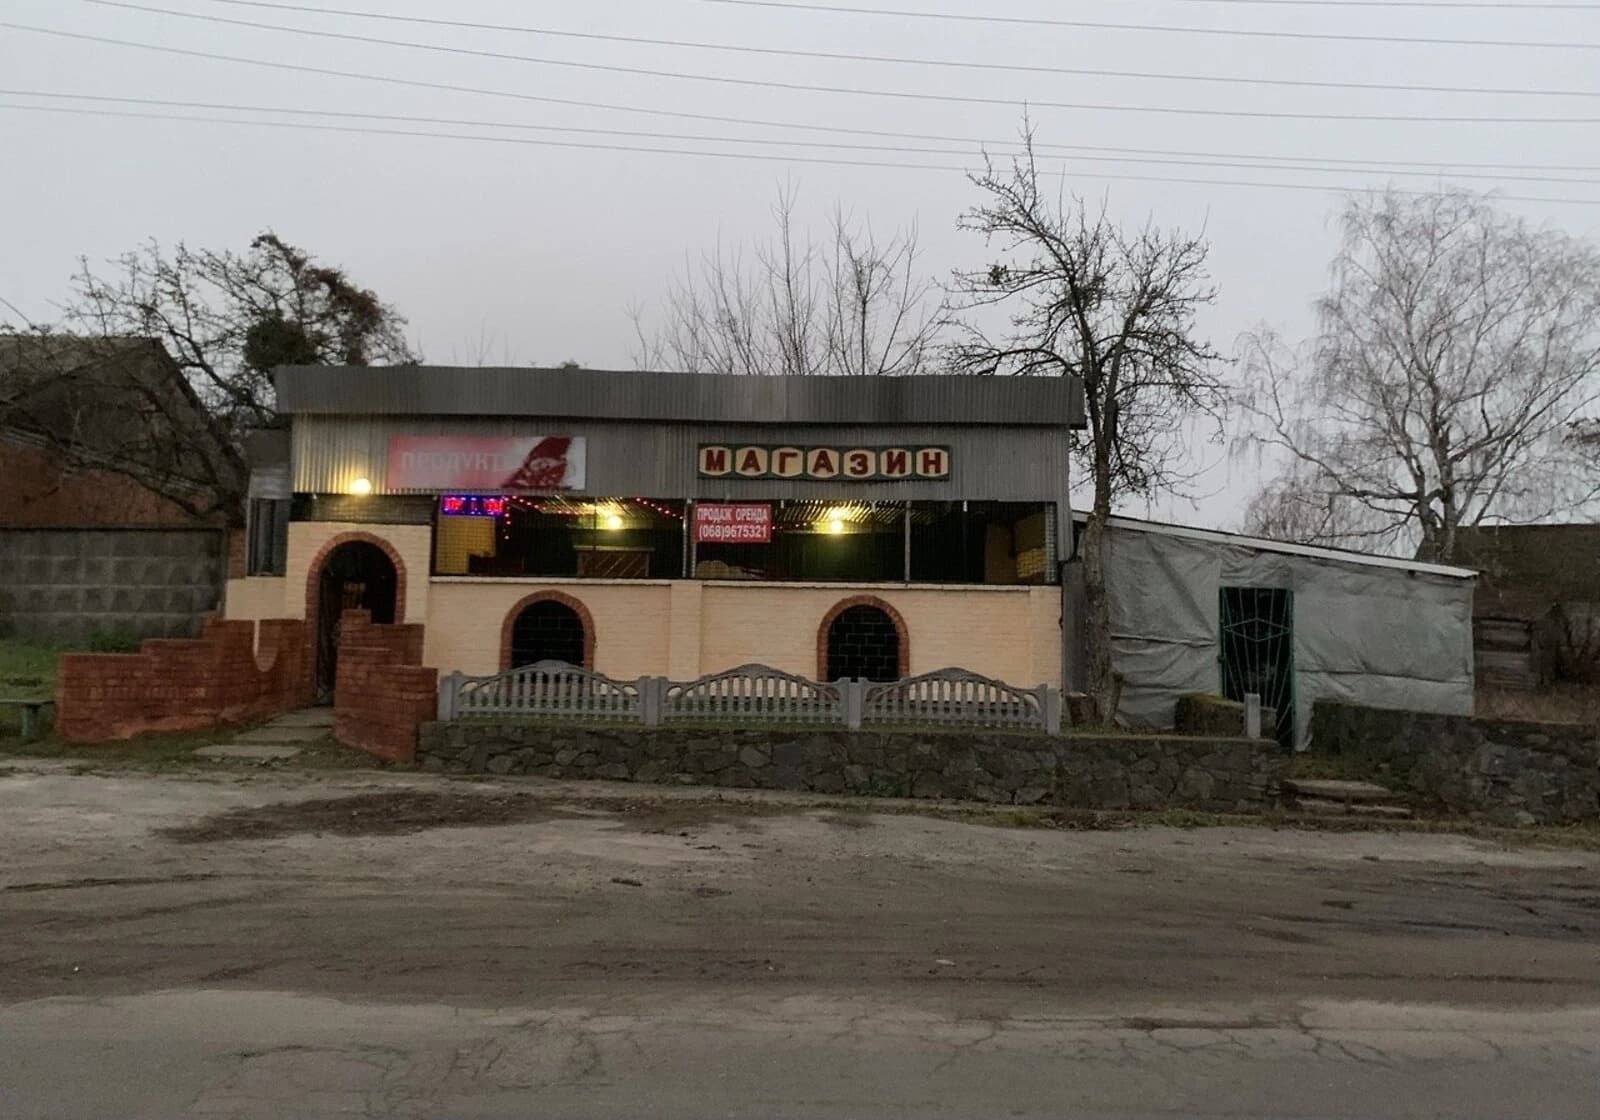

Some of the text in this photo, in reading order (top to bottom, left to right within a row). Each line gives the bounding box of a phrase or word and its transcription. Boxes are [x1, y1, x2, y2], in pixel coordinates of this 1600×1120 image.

[705, 449, 942, 475] МАГАЗИН
[697, 507, 768, 523] ПРОДАЖ ОРЕНДА
